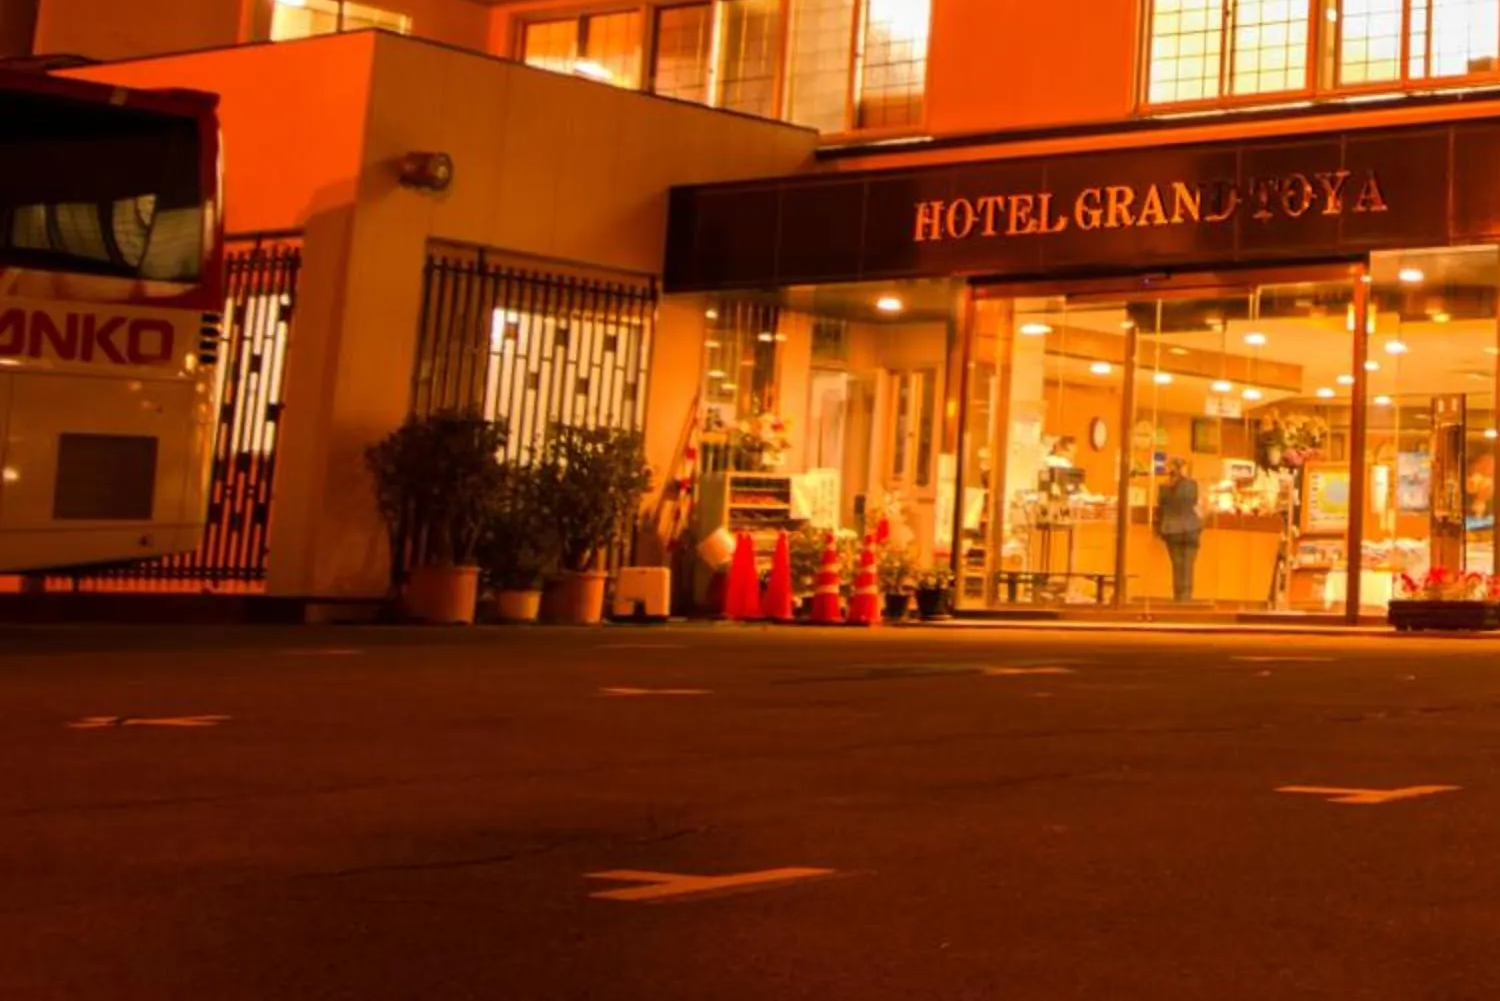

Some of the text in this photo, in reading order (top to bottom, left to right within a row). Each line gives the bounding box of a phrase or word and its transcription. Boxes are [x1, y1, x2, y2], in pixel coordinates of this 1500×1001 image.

[913, 169, 1388, 242] HOTEL GRAND TOYA
